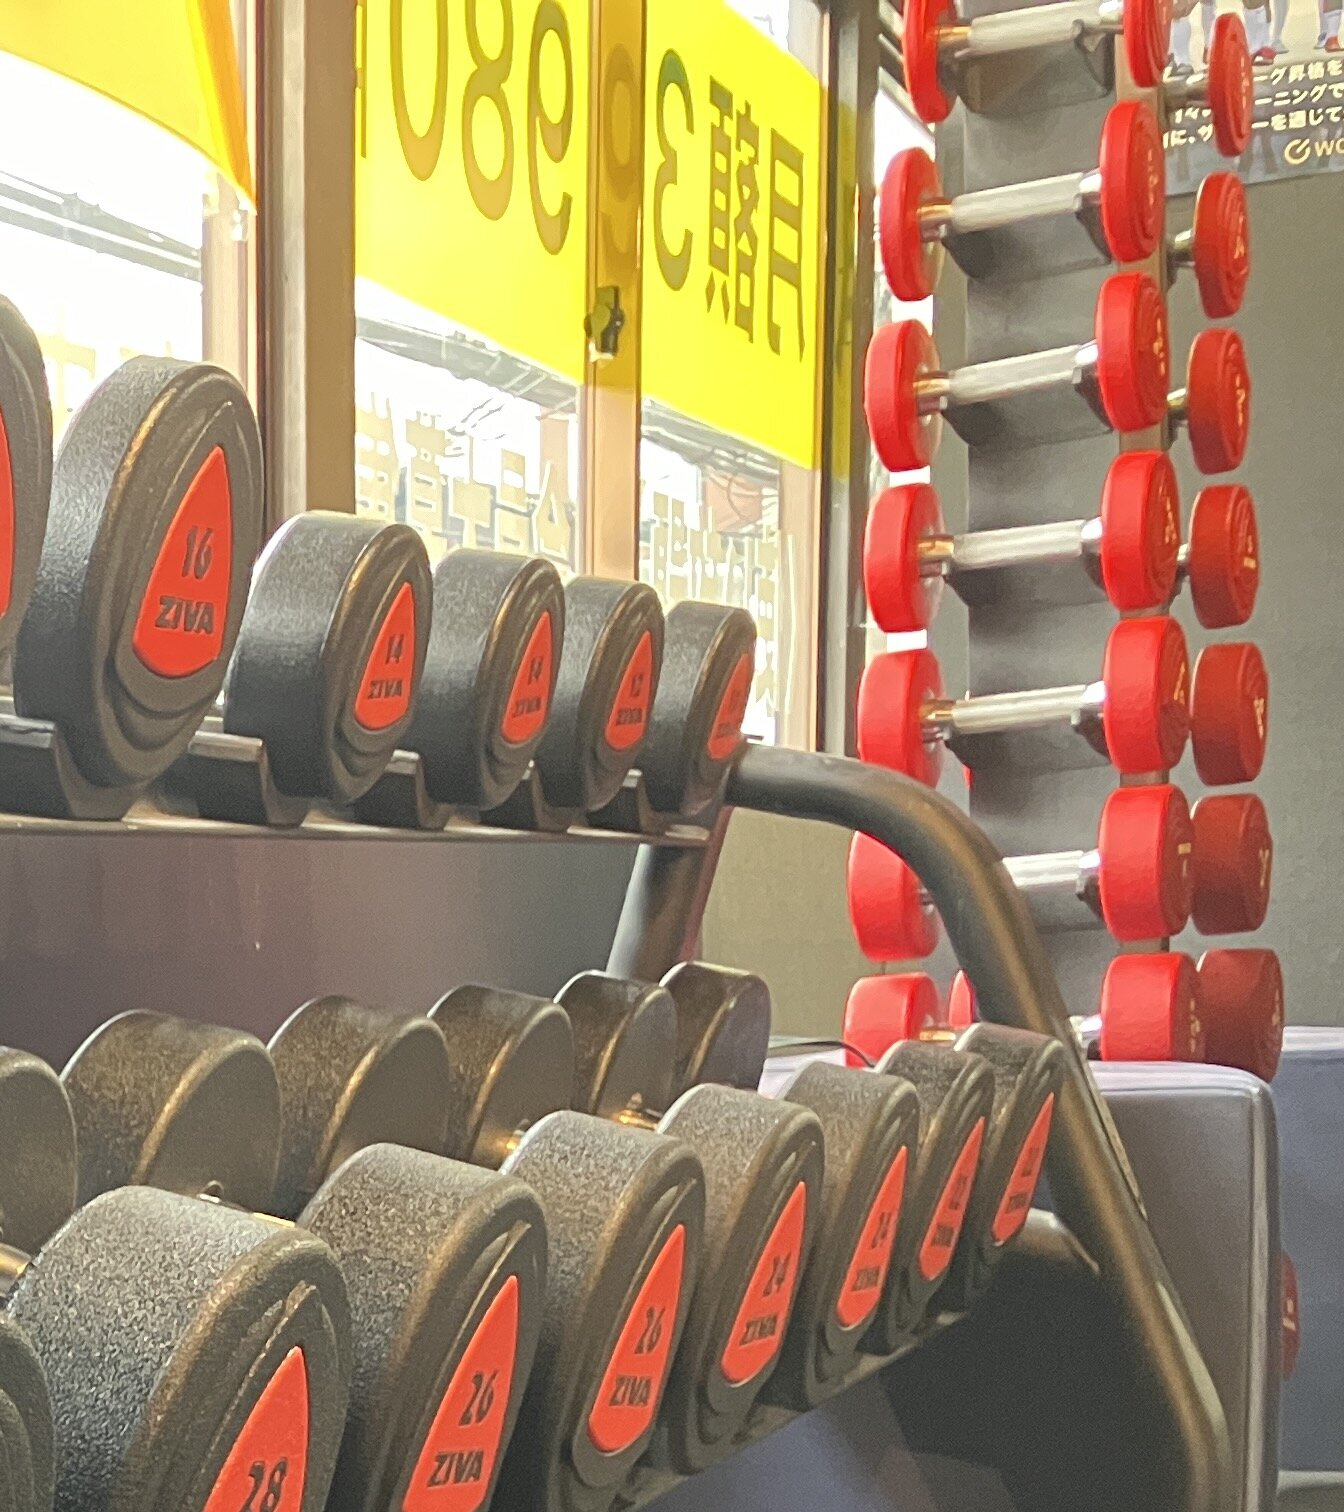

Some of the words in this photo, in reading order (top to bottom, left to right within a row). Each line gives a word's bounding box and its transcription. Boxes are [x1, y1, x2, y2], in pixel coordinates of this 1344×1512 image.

[180, 525, 213, 581] 16
[154, 595, 215, 635] ZIVA
[634, 1305, 666, 1355] 26
[457, 1370, 497, 1427] 26
[609, 1375, 652, 1407] ZIVA
[427, 1451, 485, 1488] ZIVA
